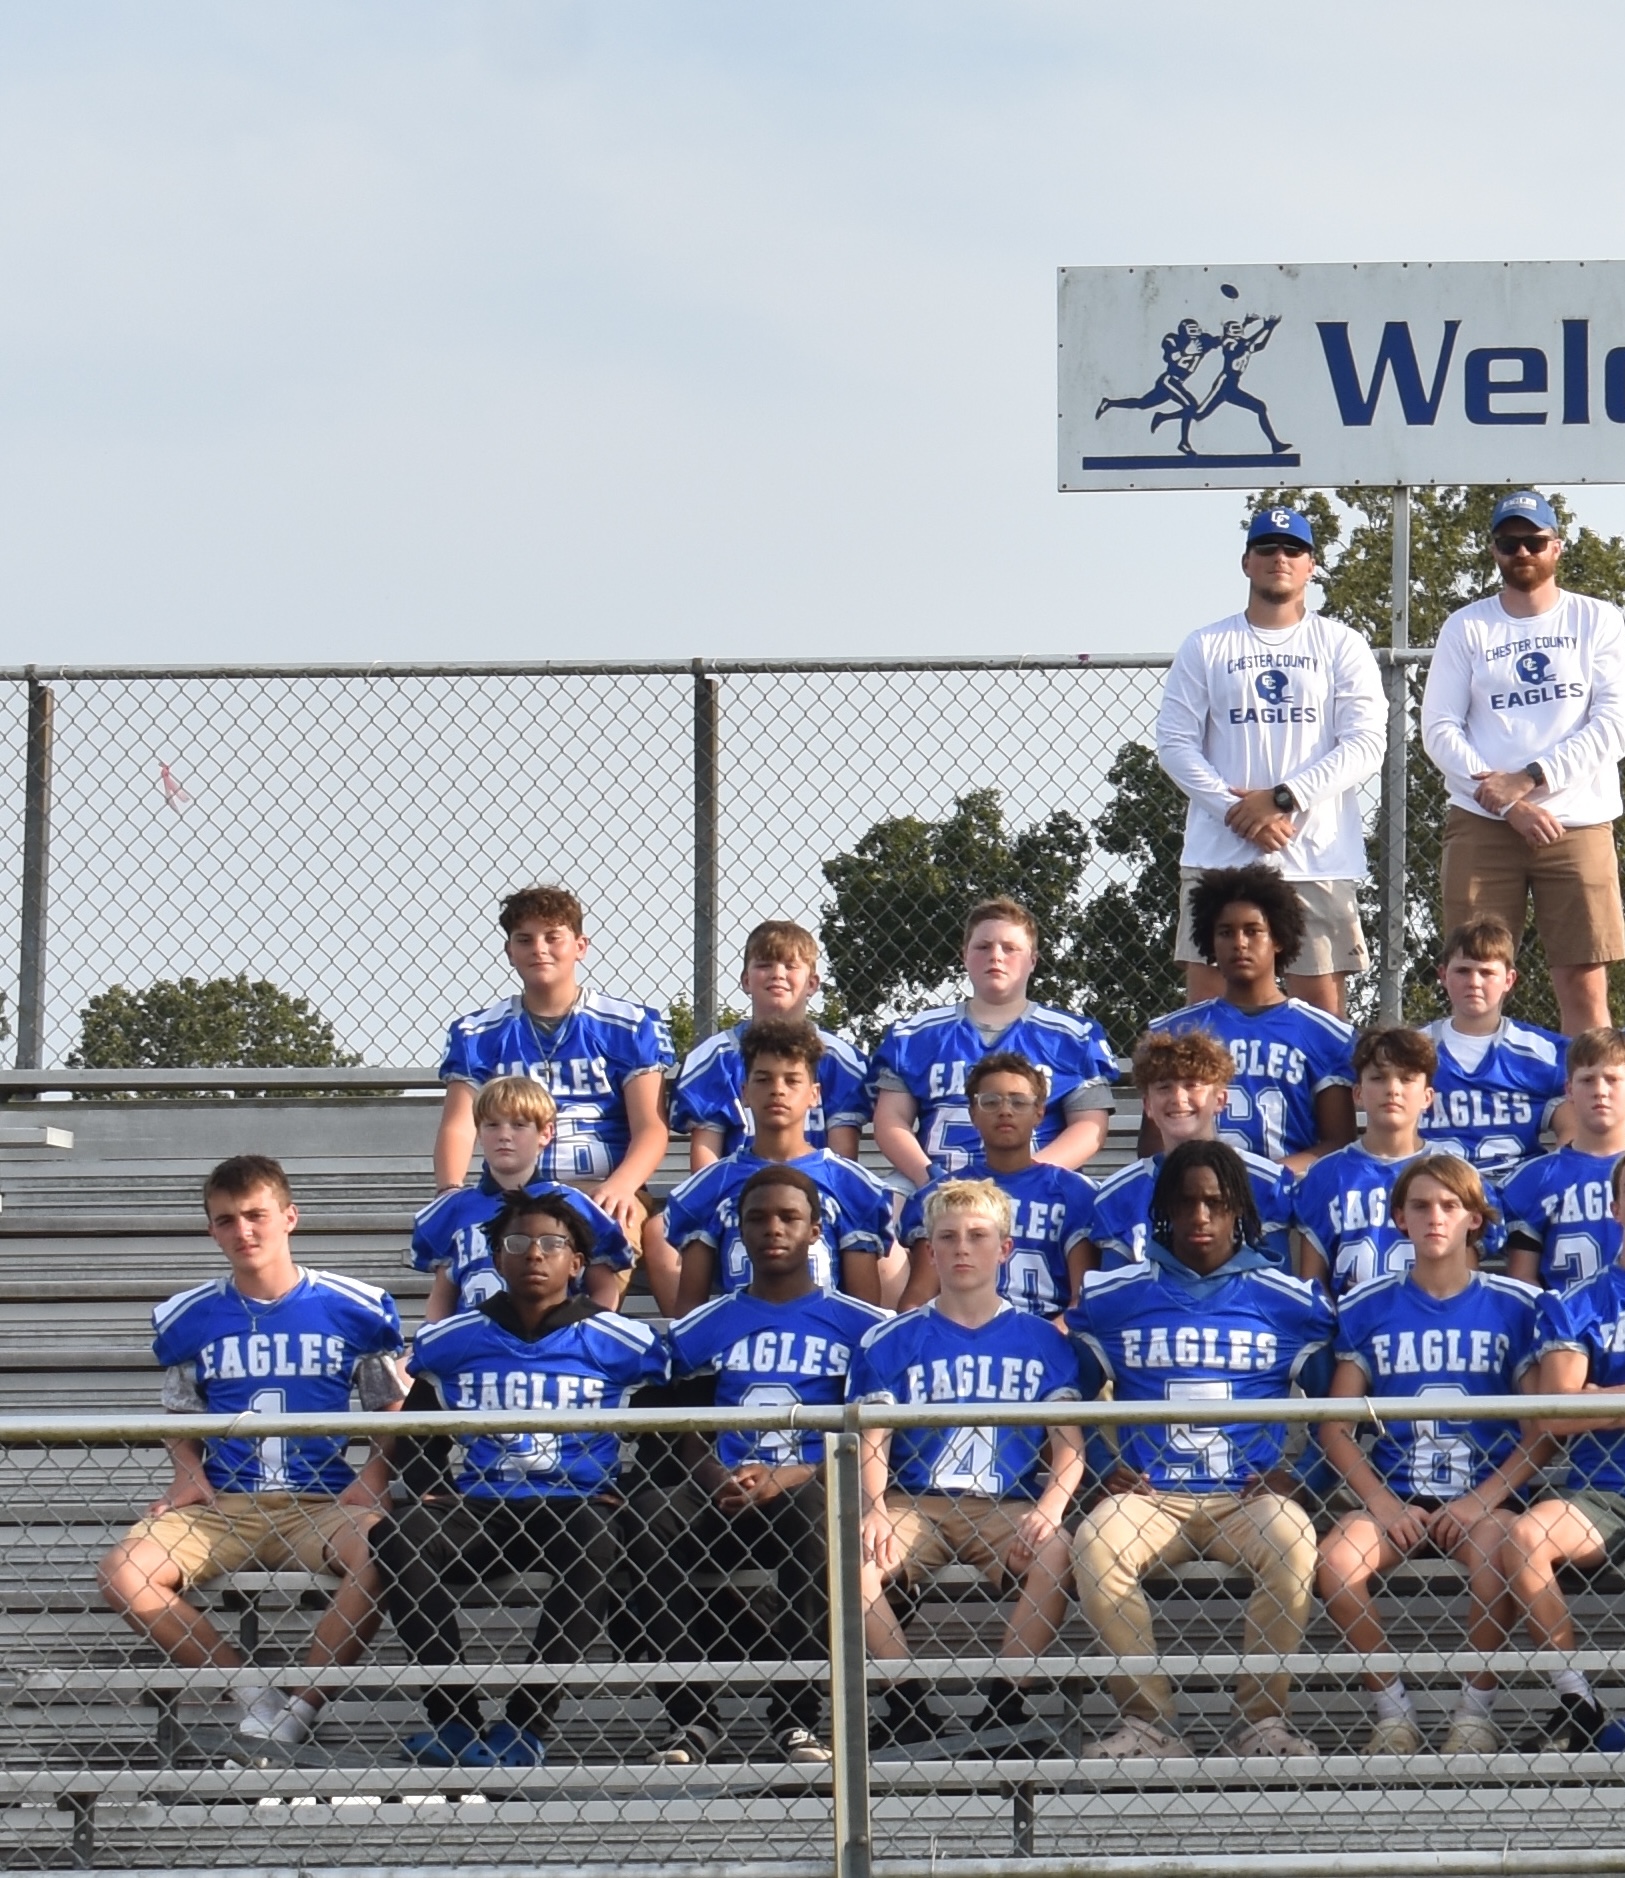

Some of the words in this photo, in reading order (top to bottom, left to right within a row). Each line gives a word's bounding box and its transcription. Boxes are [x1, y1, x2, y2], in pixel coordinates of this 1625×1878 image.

[1227, 653, 1274, 674] CHESTER
[1276, 654, 1319, 673] COUNTY
[1485, 637, 1533, 663] CHESTER
[1535, 635, 1579, 652] COUNTY
[1229, 705, 1317, 726] EAGLES
[1490, 682, 1585, 711] EAGLES
[200, 1332, 346, 1380] EAGLES
[1121, 1327, 1278, 1371] EAGLES
[1371, 1328, 1510, 1376] EAGLES
[457, 1371, 605, 1410] EAGLES
[907, 1354, 1045, 1404] EAGLES
[248, 1388, 297, 1491] 1
[1164, 1378, 1235, 1480] 5
[1410, 1382, 1476, 1498] 6
[929, 1424, 1003, 1497] 4
